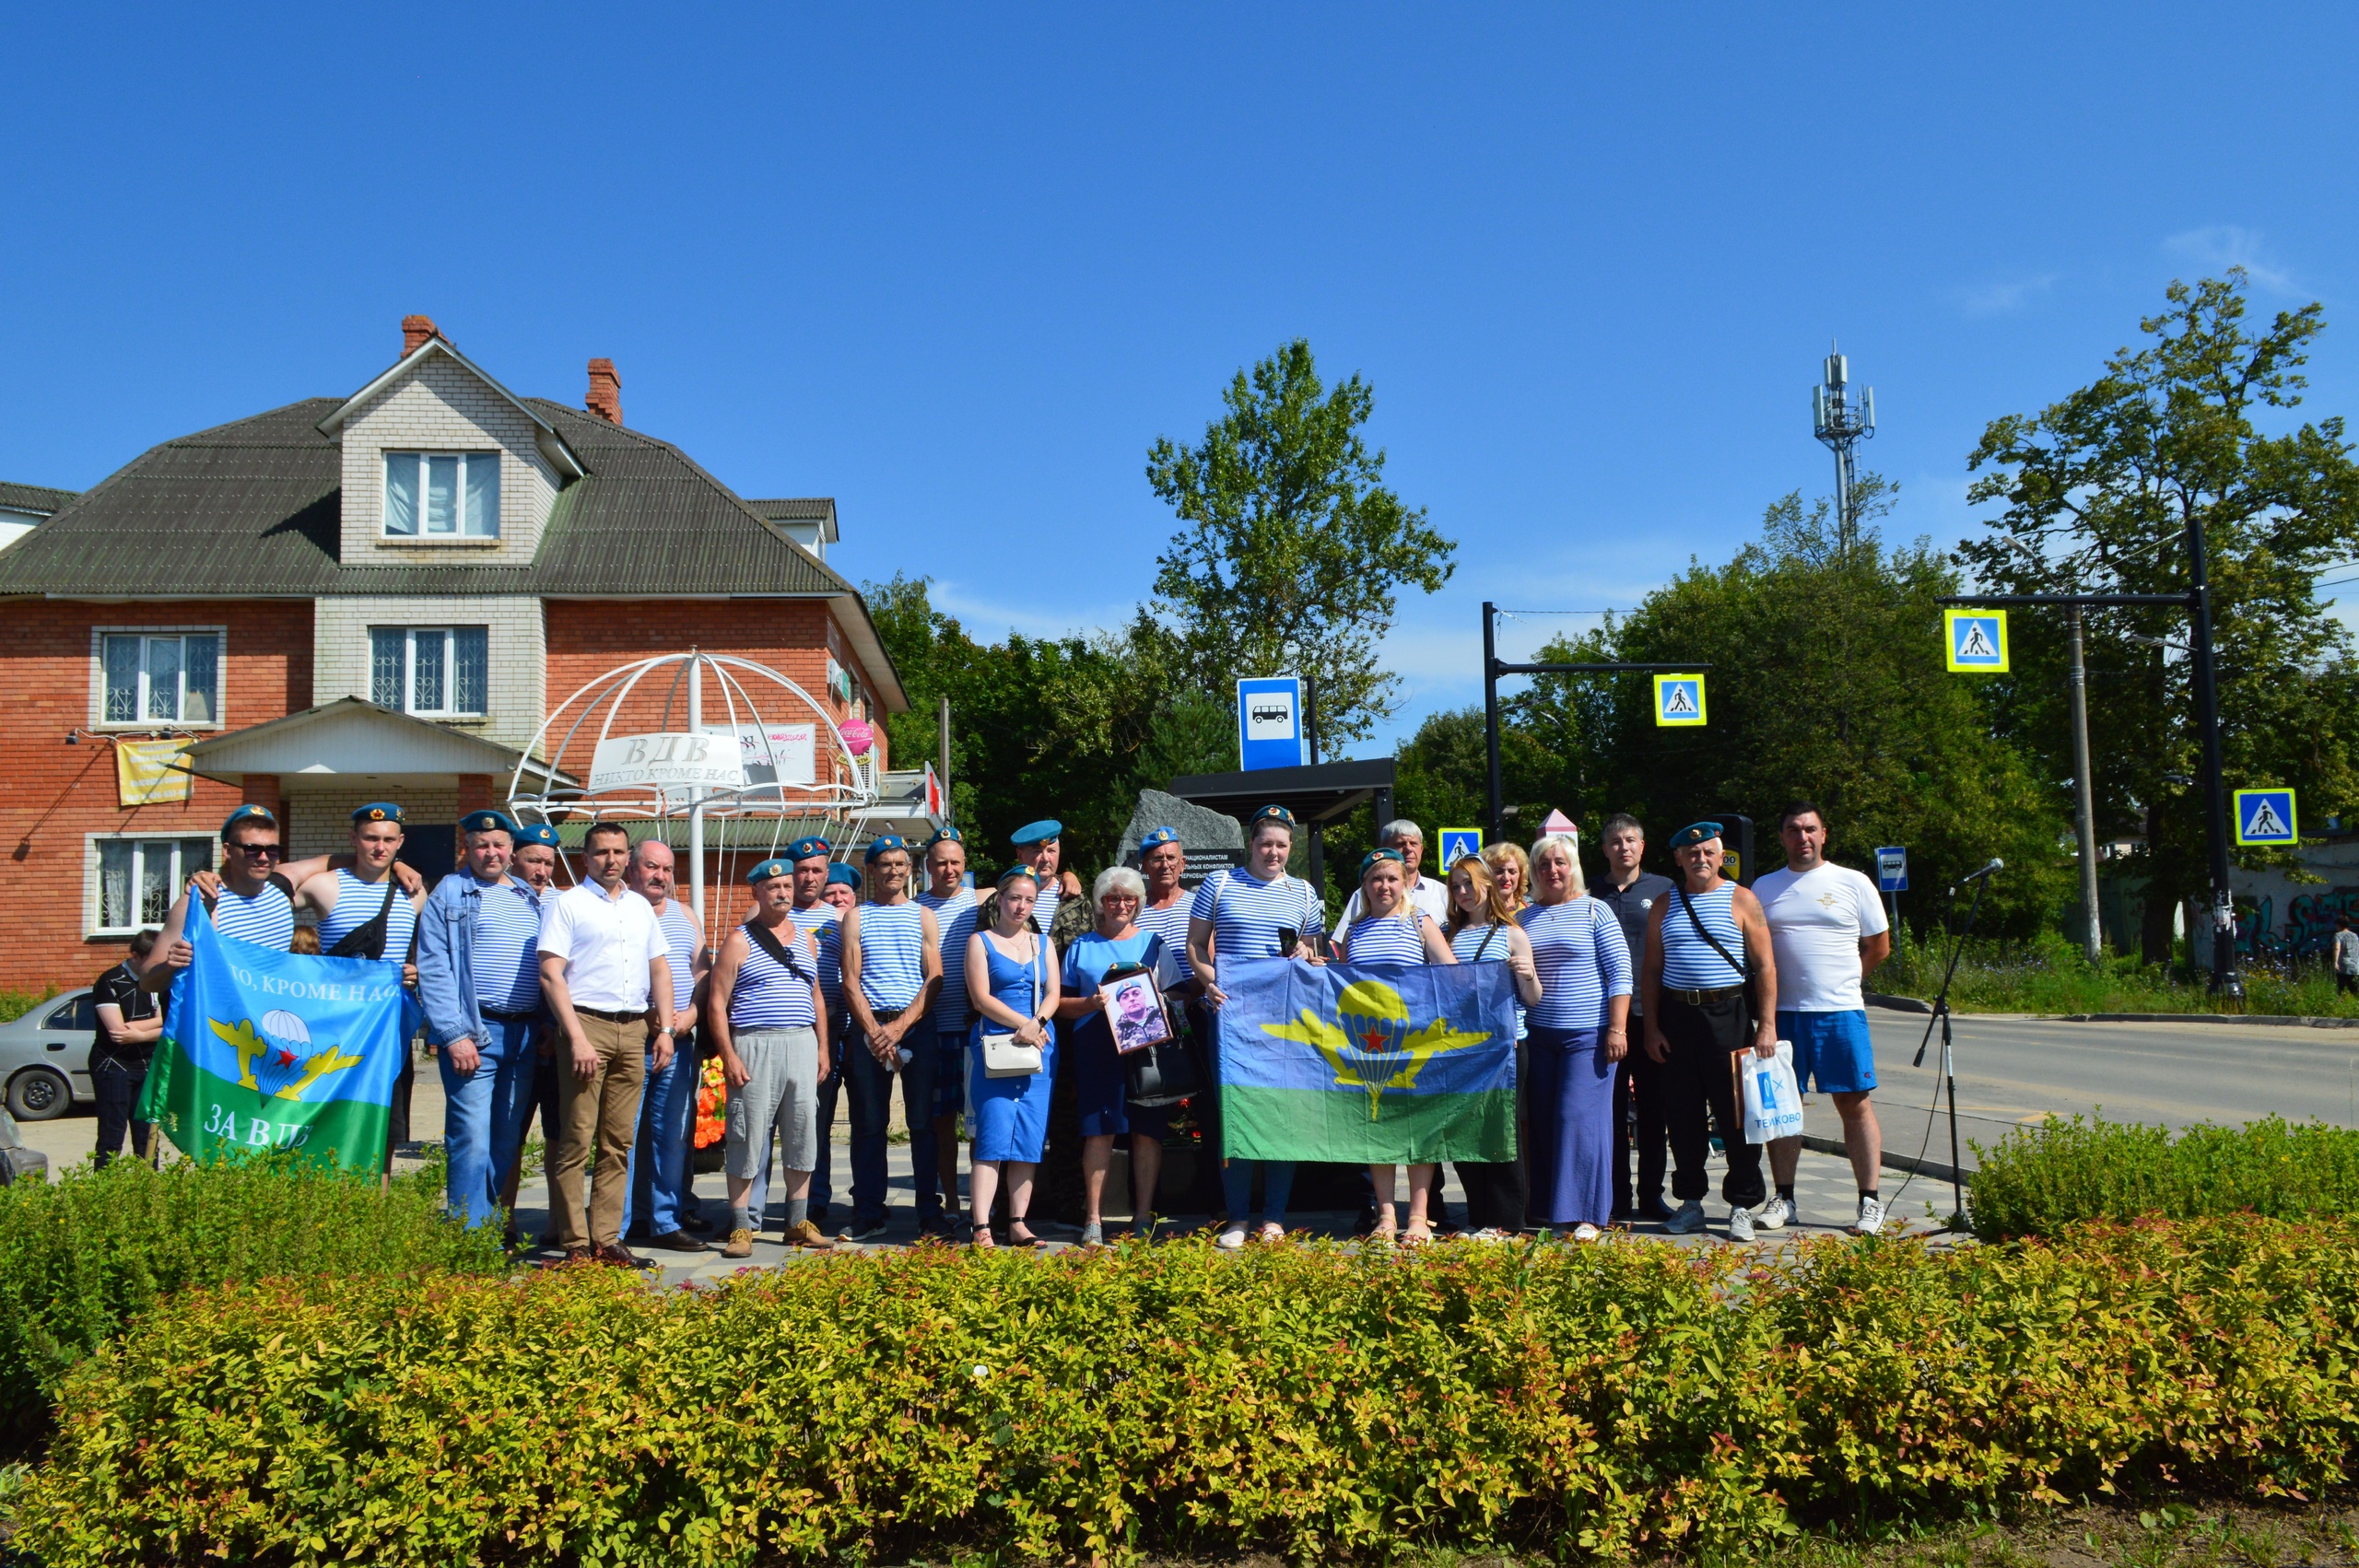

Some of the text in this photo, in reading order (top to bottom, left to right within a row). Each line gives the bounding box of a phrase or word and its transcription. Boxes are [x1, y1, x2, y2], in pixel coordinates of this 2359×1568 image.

[621, 736, 710, 770] ВДВ
[839, 755, 869, 764] ПРКТЫ
[593, 767, 738, 786] НИКТО КРОМЕ НАС
[262, 976, 342, 1000] КРОМЕ
[204, 1104, 237, 1141] ЗА
